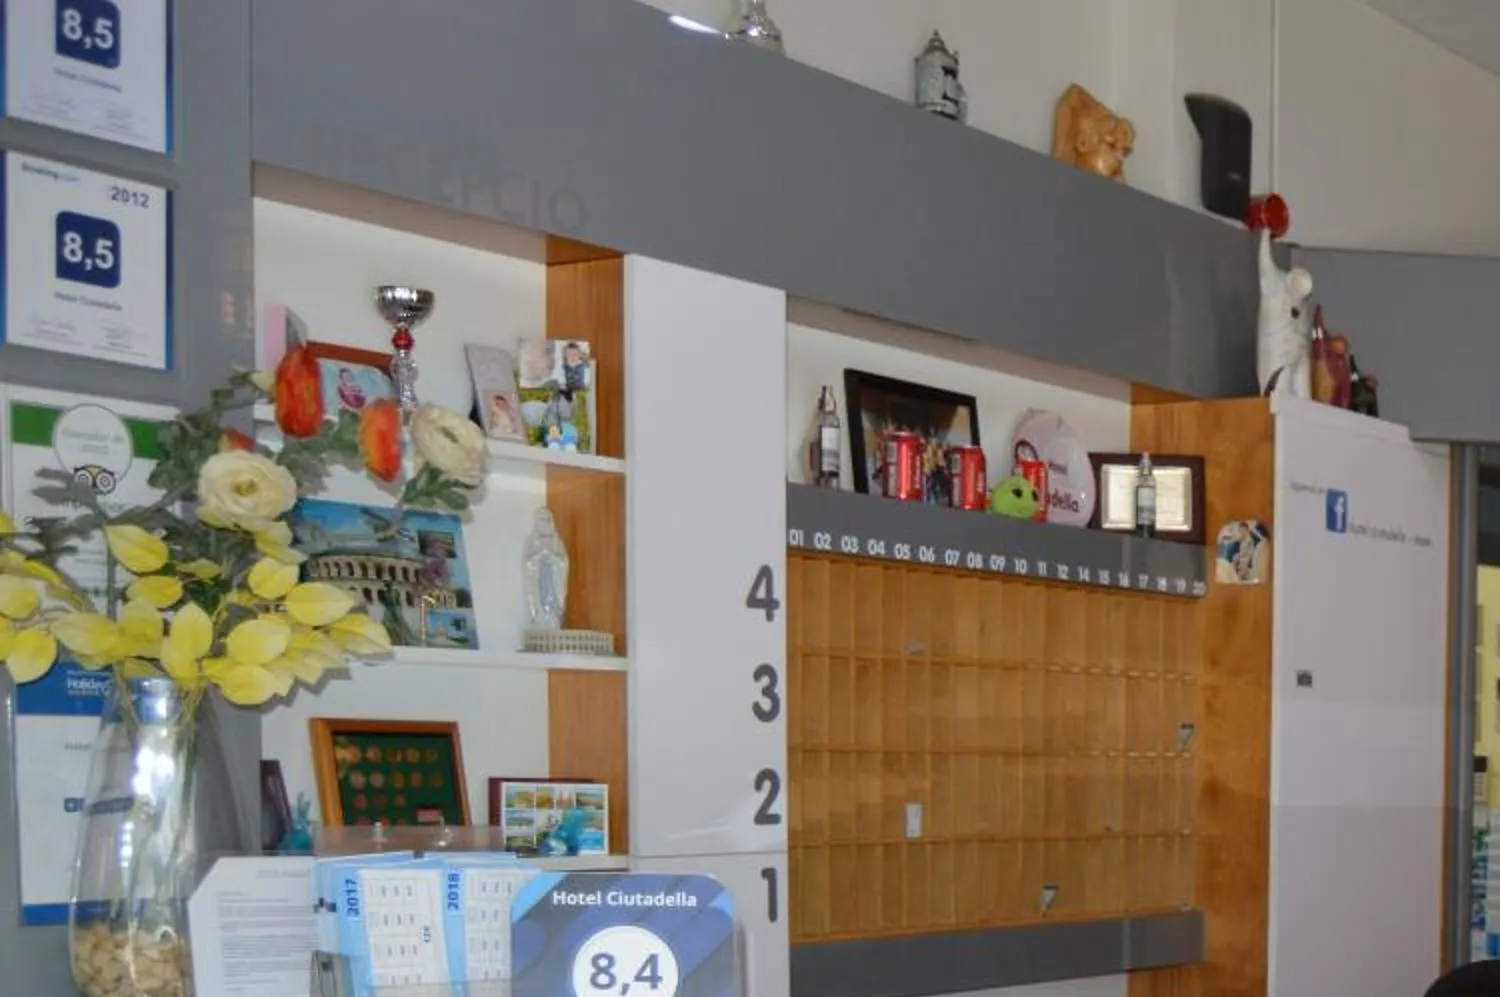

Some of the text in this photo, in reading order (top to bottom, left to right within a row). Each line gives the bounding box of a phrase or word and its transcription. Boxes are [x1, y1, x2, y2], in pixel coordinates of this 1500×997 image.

[63, 8, 114, 50] 8,5
[111, 186, 150, 208] 2012
[63, 230, 115, 271] 8,5
[789, 528, 804, 546] 01
[814, 532, 832, 550] 02
[841, 536, 859, 553] 03
[867, 538, 885, 556] 04
[894, 543, 911, 560] 05
[919, 546, 935, 563] 06
[945, 549, 960, 566] 07
[967, 552, 983, 569] 08
[990, 555, 1006, 572] 09
[1014, 558, 1028, 575] 10
[1037, 561, 1048, 577] 11
[1057, 564, 1069, 580] 12
[745, 564, 780, 622] 4
[752, 664, 780, 723] 3
[753, 768, 781, 825] 2
[345, 878, 360, 917] 2017
[447, 872, 461, 911] 2018
[553, 891, 698, 908] Hotel Ciutadella
[761, 867, 778, 923] 1
[589, 953, 663, 996] 8,4
